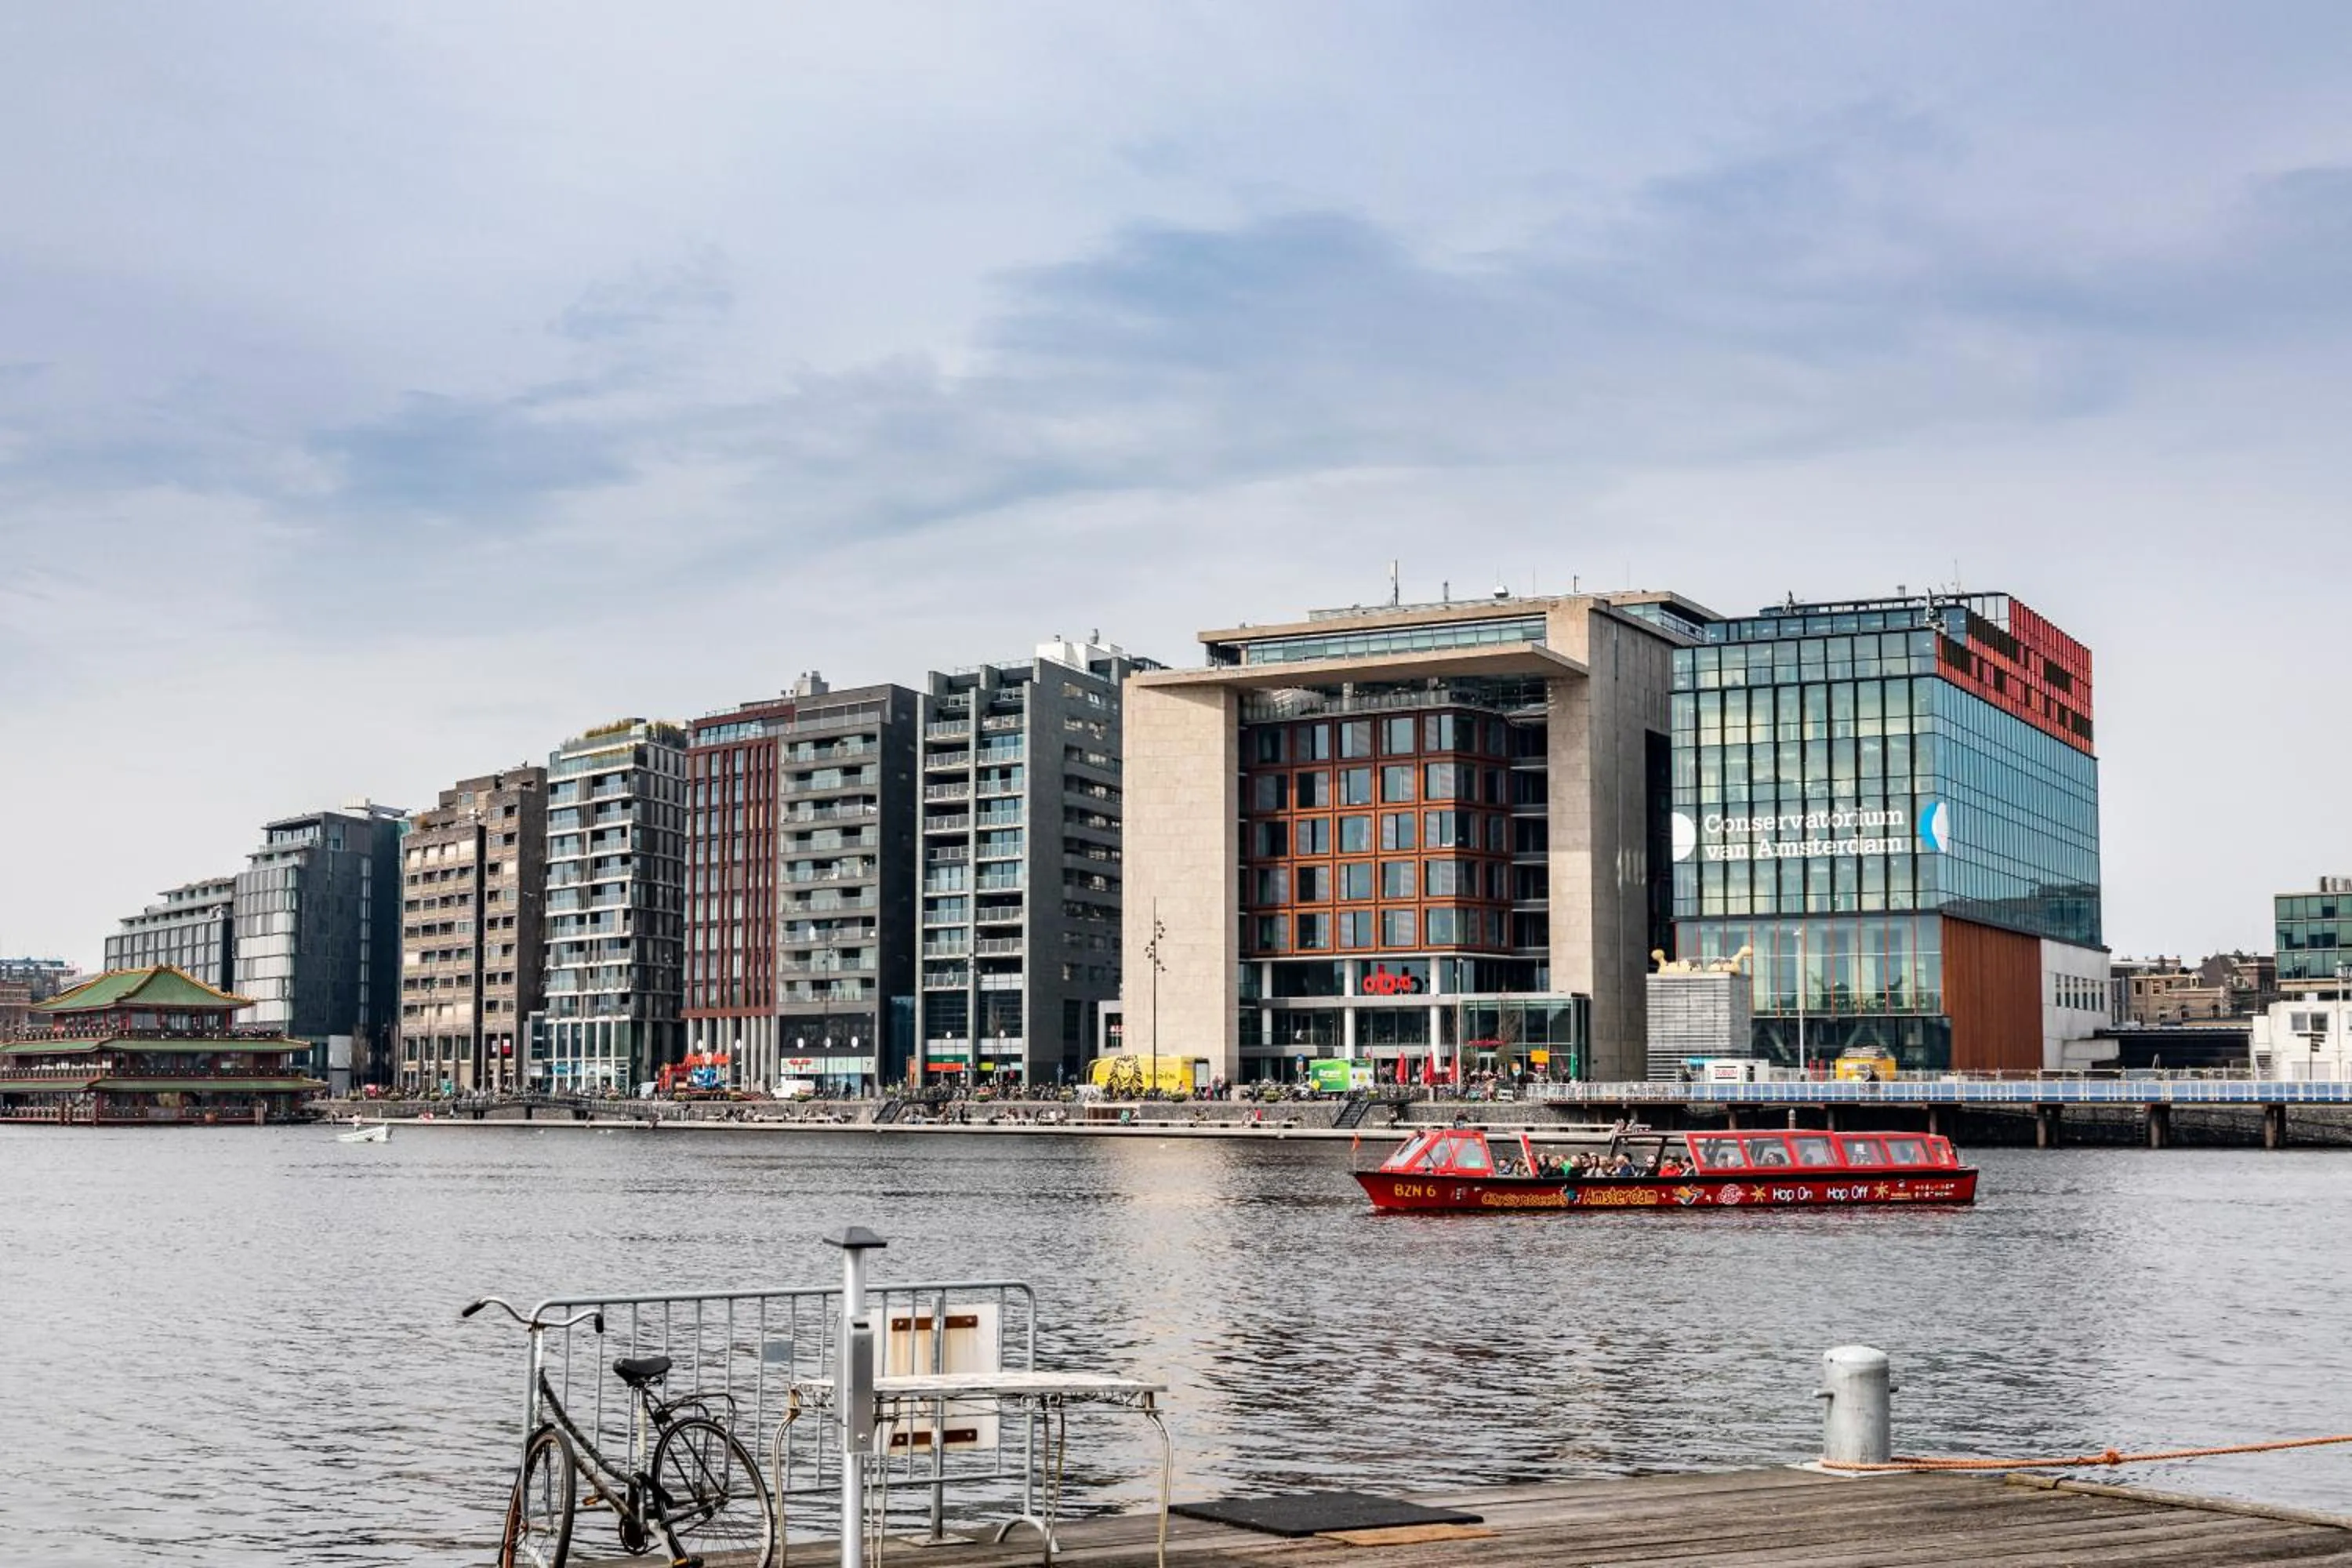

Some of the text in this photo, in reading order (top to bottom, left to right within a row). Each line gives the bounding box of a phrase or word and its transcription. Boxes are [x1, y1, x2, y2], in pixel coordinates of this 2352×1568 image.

[1704, 808, 1904, 833] Conservatorium
[1705, 835, 1903, 860] van Amsterdam
[1394, 1184, 1437, 1197] BZN 6
[1583, 1186, 1658, 1205] Amsterdam
[1772, 1186, 1813, 1202] Hop On
[1827, 1185, 1869, 1200] Hop Off
